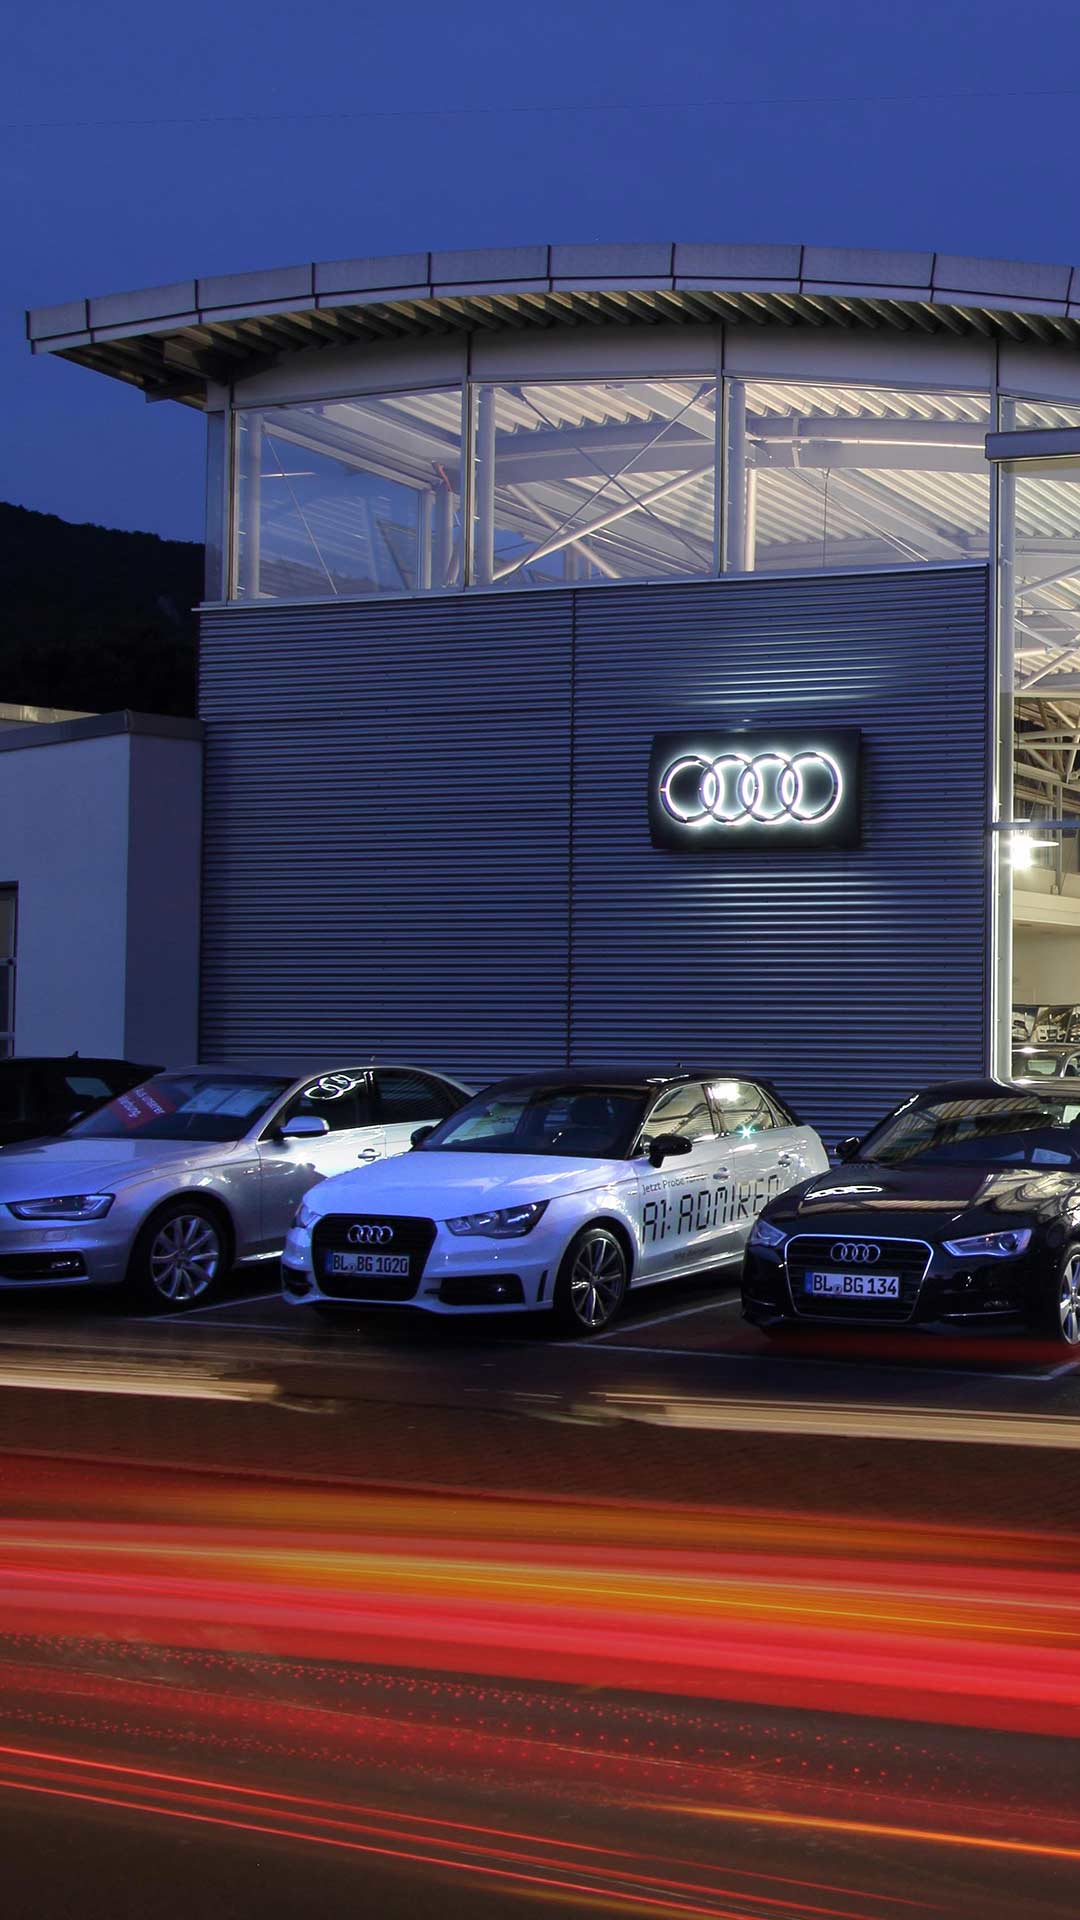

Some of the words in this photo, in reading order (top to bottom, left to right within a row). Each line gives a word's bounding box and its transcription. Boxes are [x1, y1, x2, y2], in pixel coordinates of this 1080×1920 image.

[642, 1183, 662, 1196] Jetzt
[662, 1177, 685, 1190] Probe
[333, 1254, 348, 1271] BL
[357, 1256, 373, 1272] BG
[375, 1257, 408, 1274] 1020
[813, 1274, 833, 1292] BL
[843, 1276, 864, 1294] BG
[867, 1278, 897, 1295] 134
